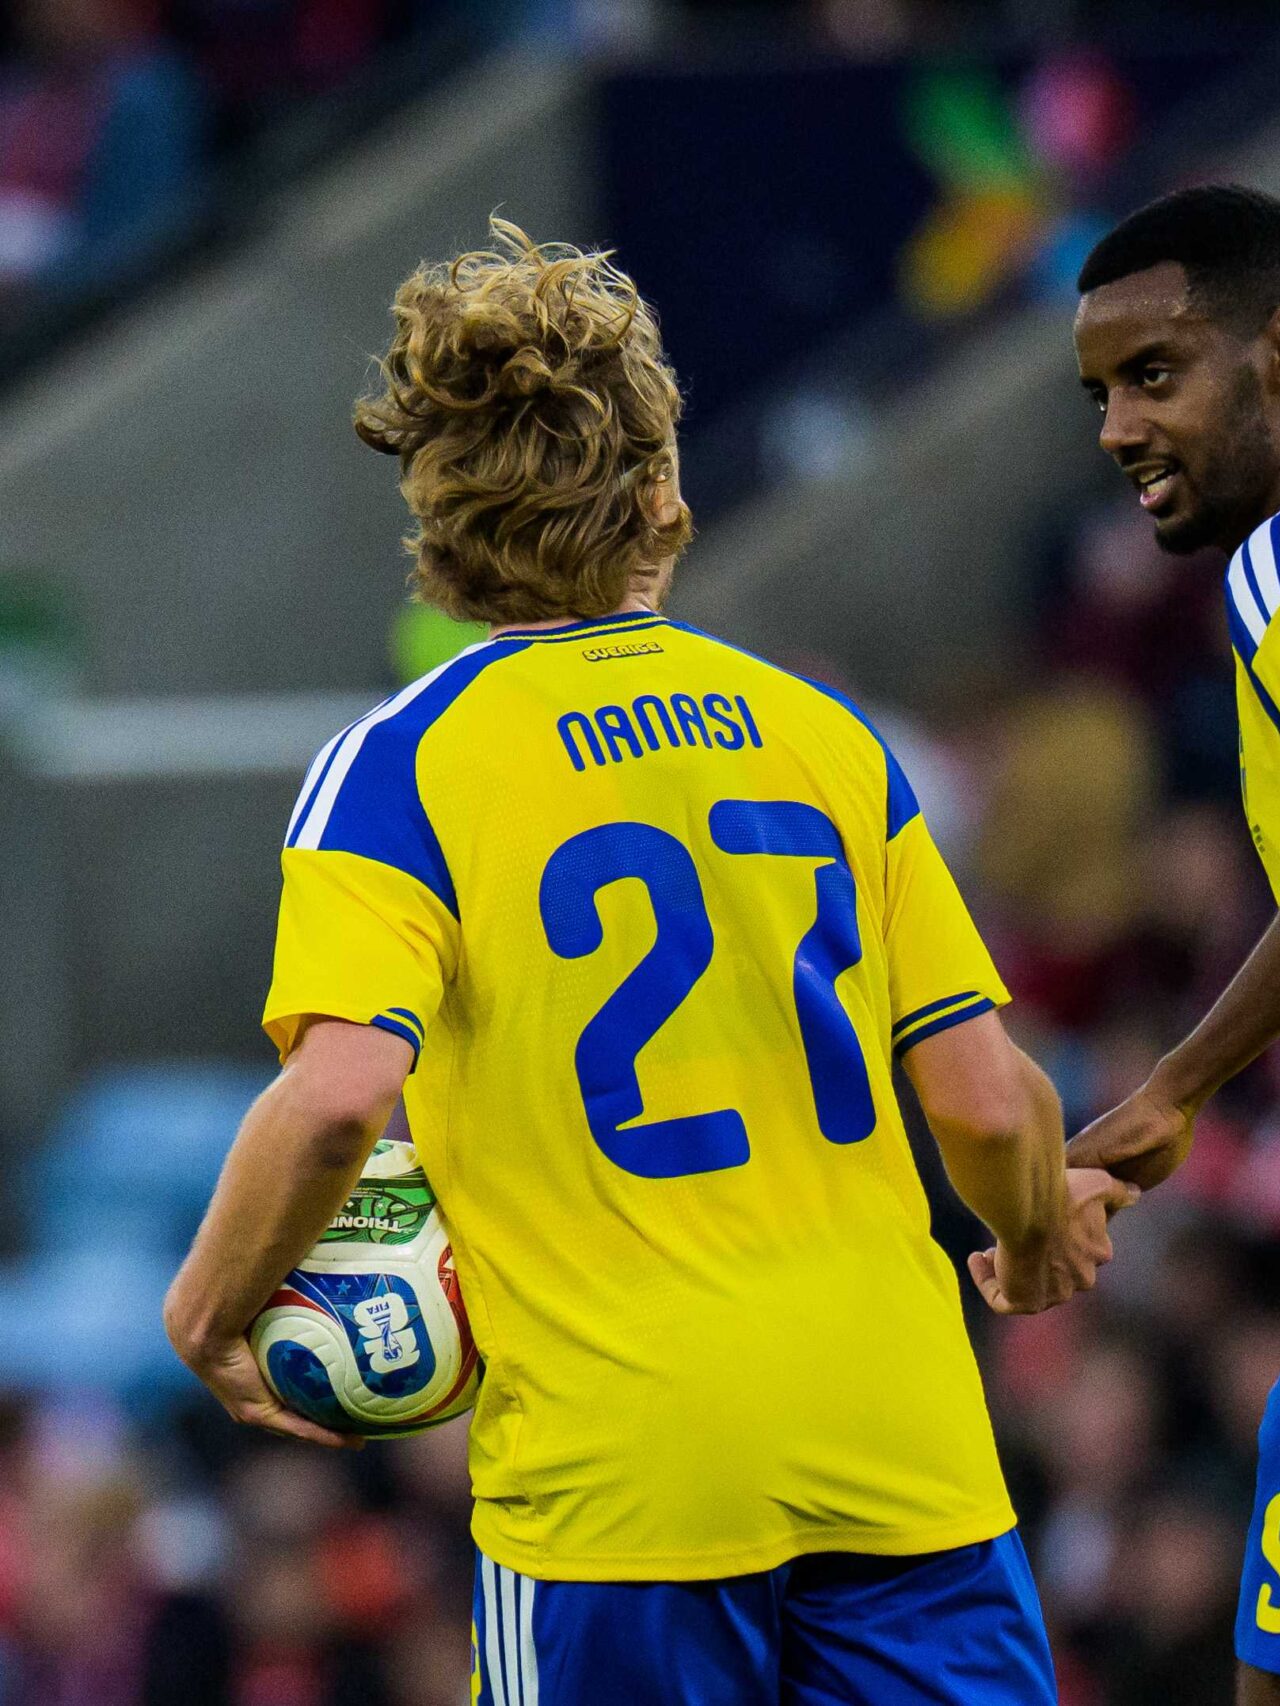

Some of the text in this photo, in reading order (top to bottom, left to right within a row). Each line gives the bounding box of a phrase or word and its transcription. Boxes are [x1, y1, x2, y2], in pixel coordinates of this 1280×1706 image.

[582, 642, 664, 662] SVERIGE
[557, 693, 763, 771] NANASI
[539, 799, 876, 1179] 27
[366, 1301, 390, 1315] FIFA
